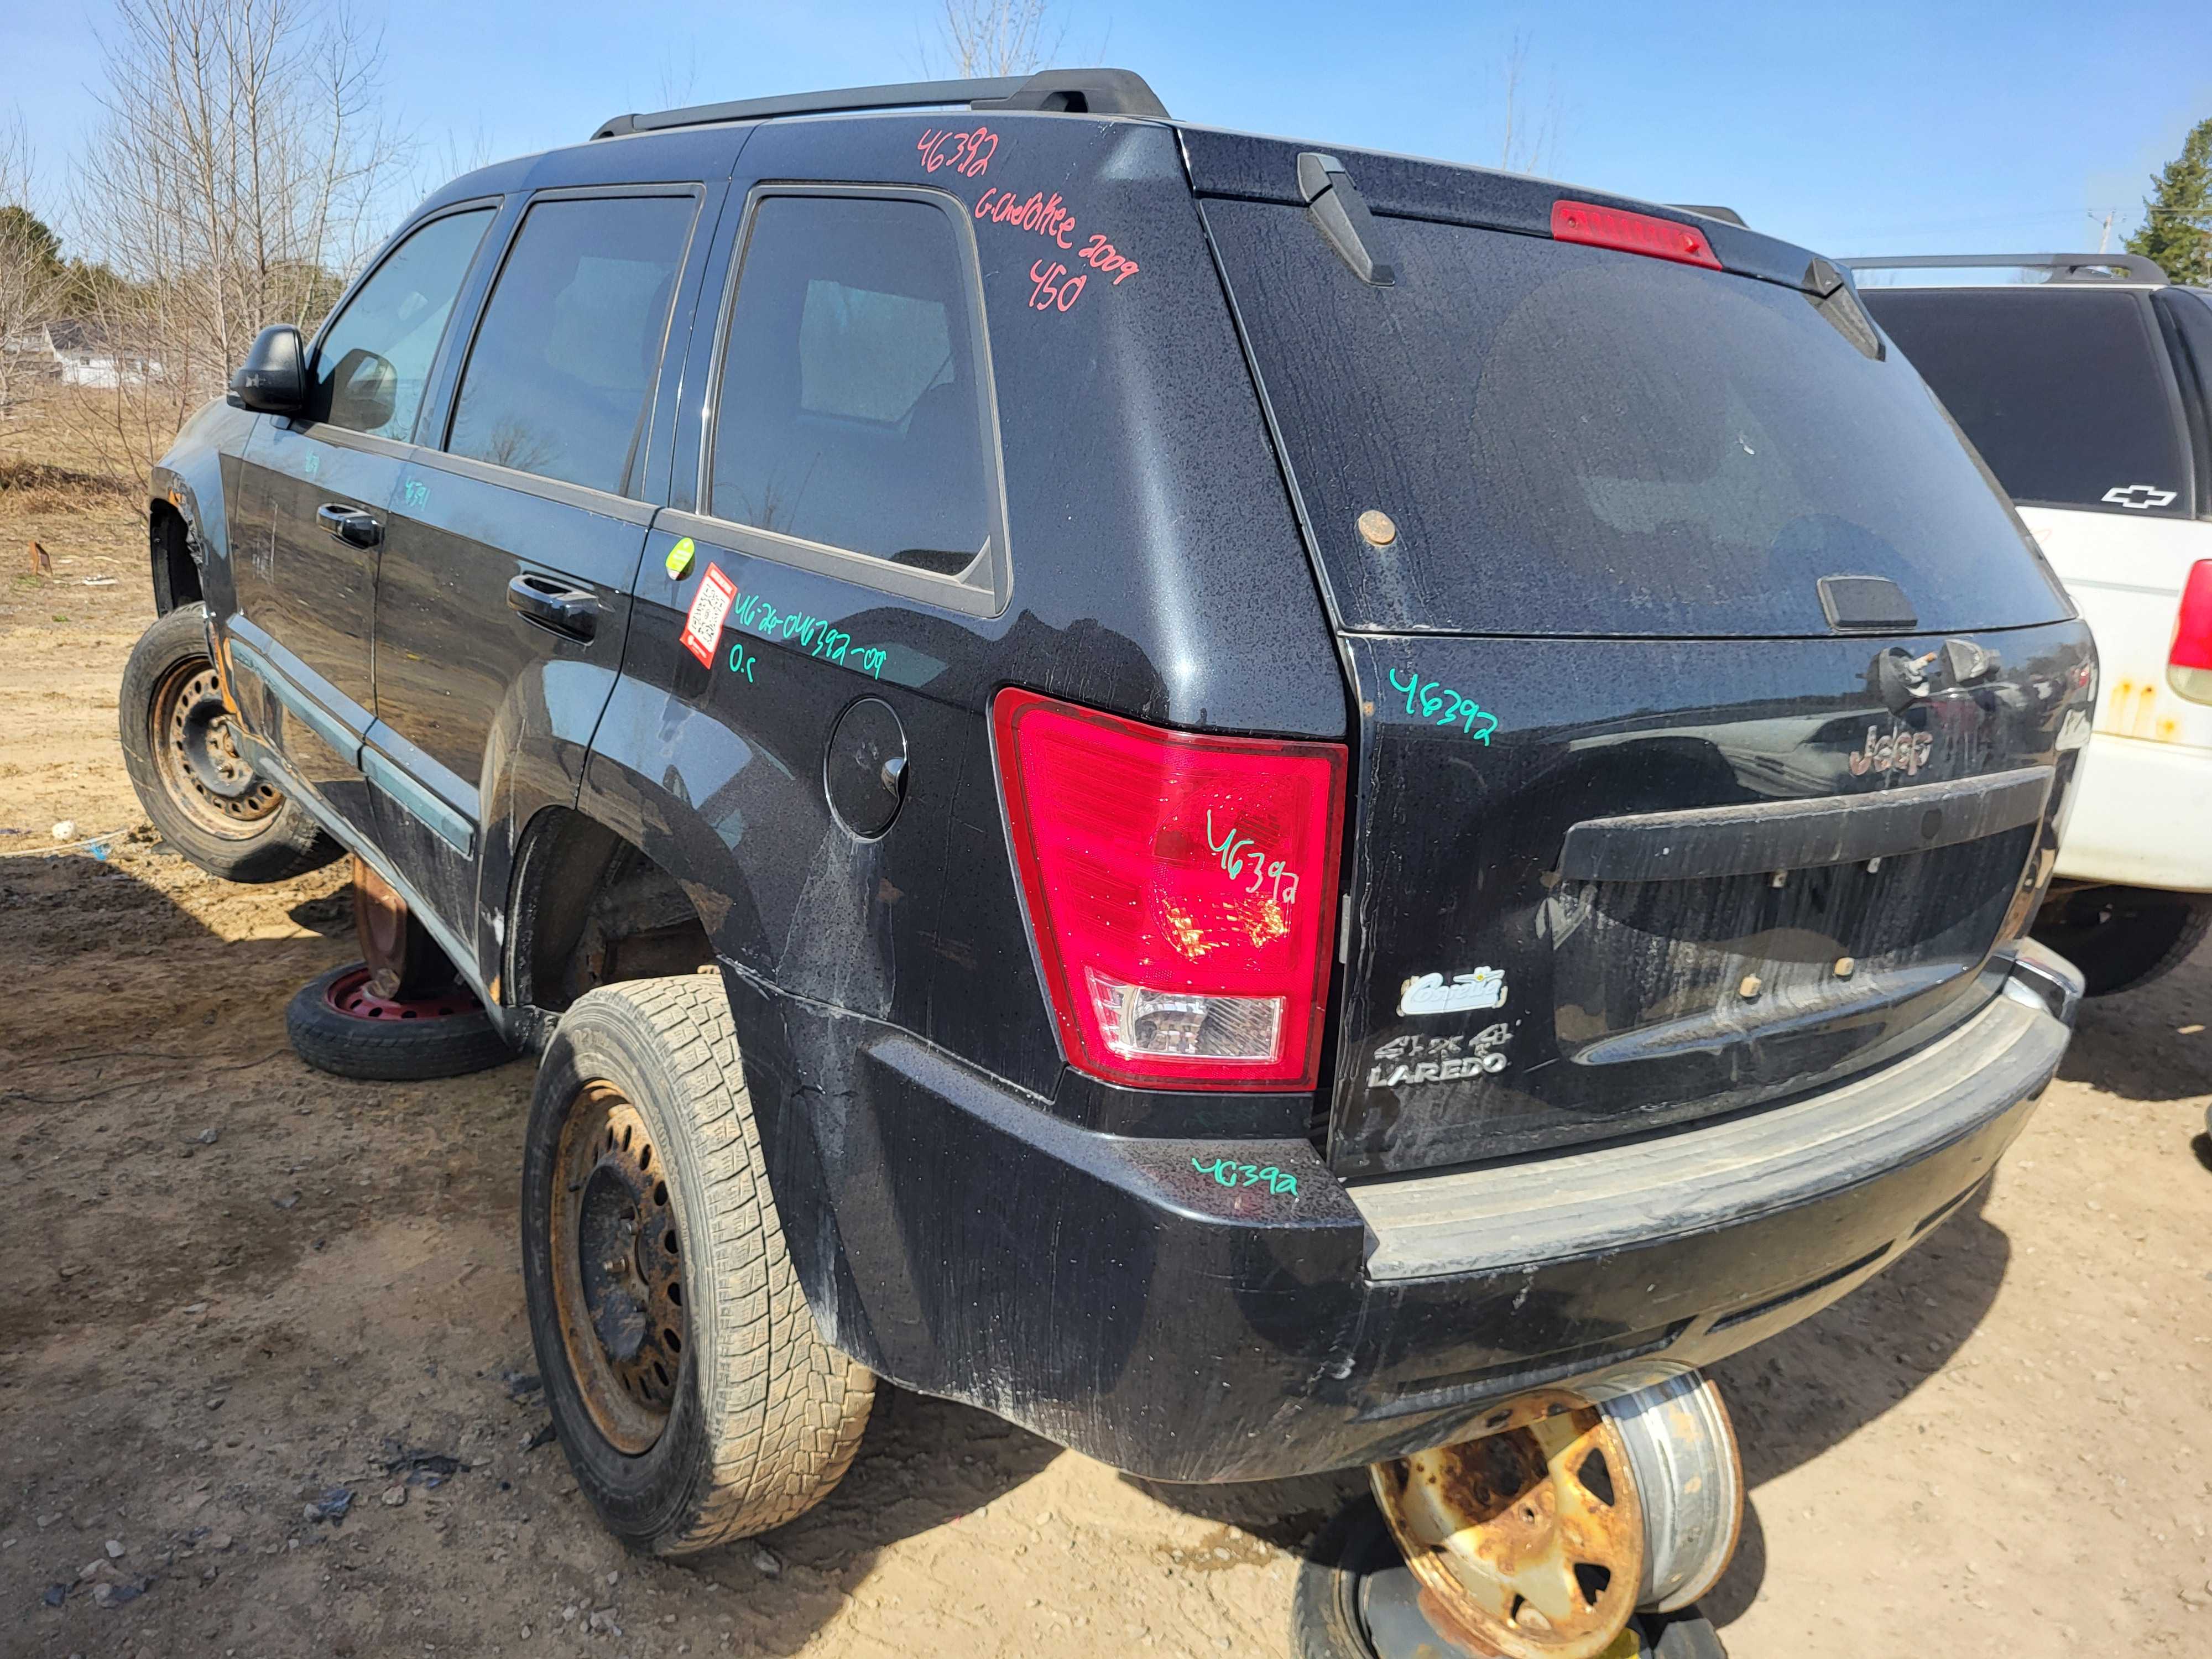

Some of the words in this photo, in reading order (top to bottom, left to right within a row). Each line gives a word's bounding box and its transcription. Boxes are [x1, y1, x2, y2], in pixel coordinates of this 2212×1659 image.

[916, 127, 999, 178] 46392
[1029, 259, 1088, 312] 450
[1078, 234, 1140, 285] 2009
[1389, 667, 1499, 747] 46392
[1849, 724, 1933, 776] Jeep
[1207, 808, 1300, 904] 46392
[1367, 1052, 1508, 1088] LAREDO
